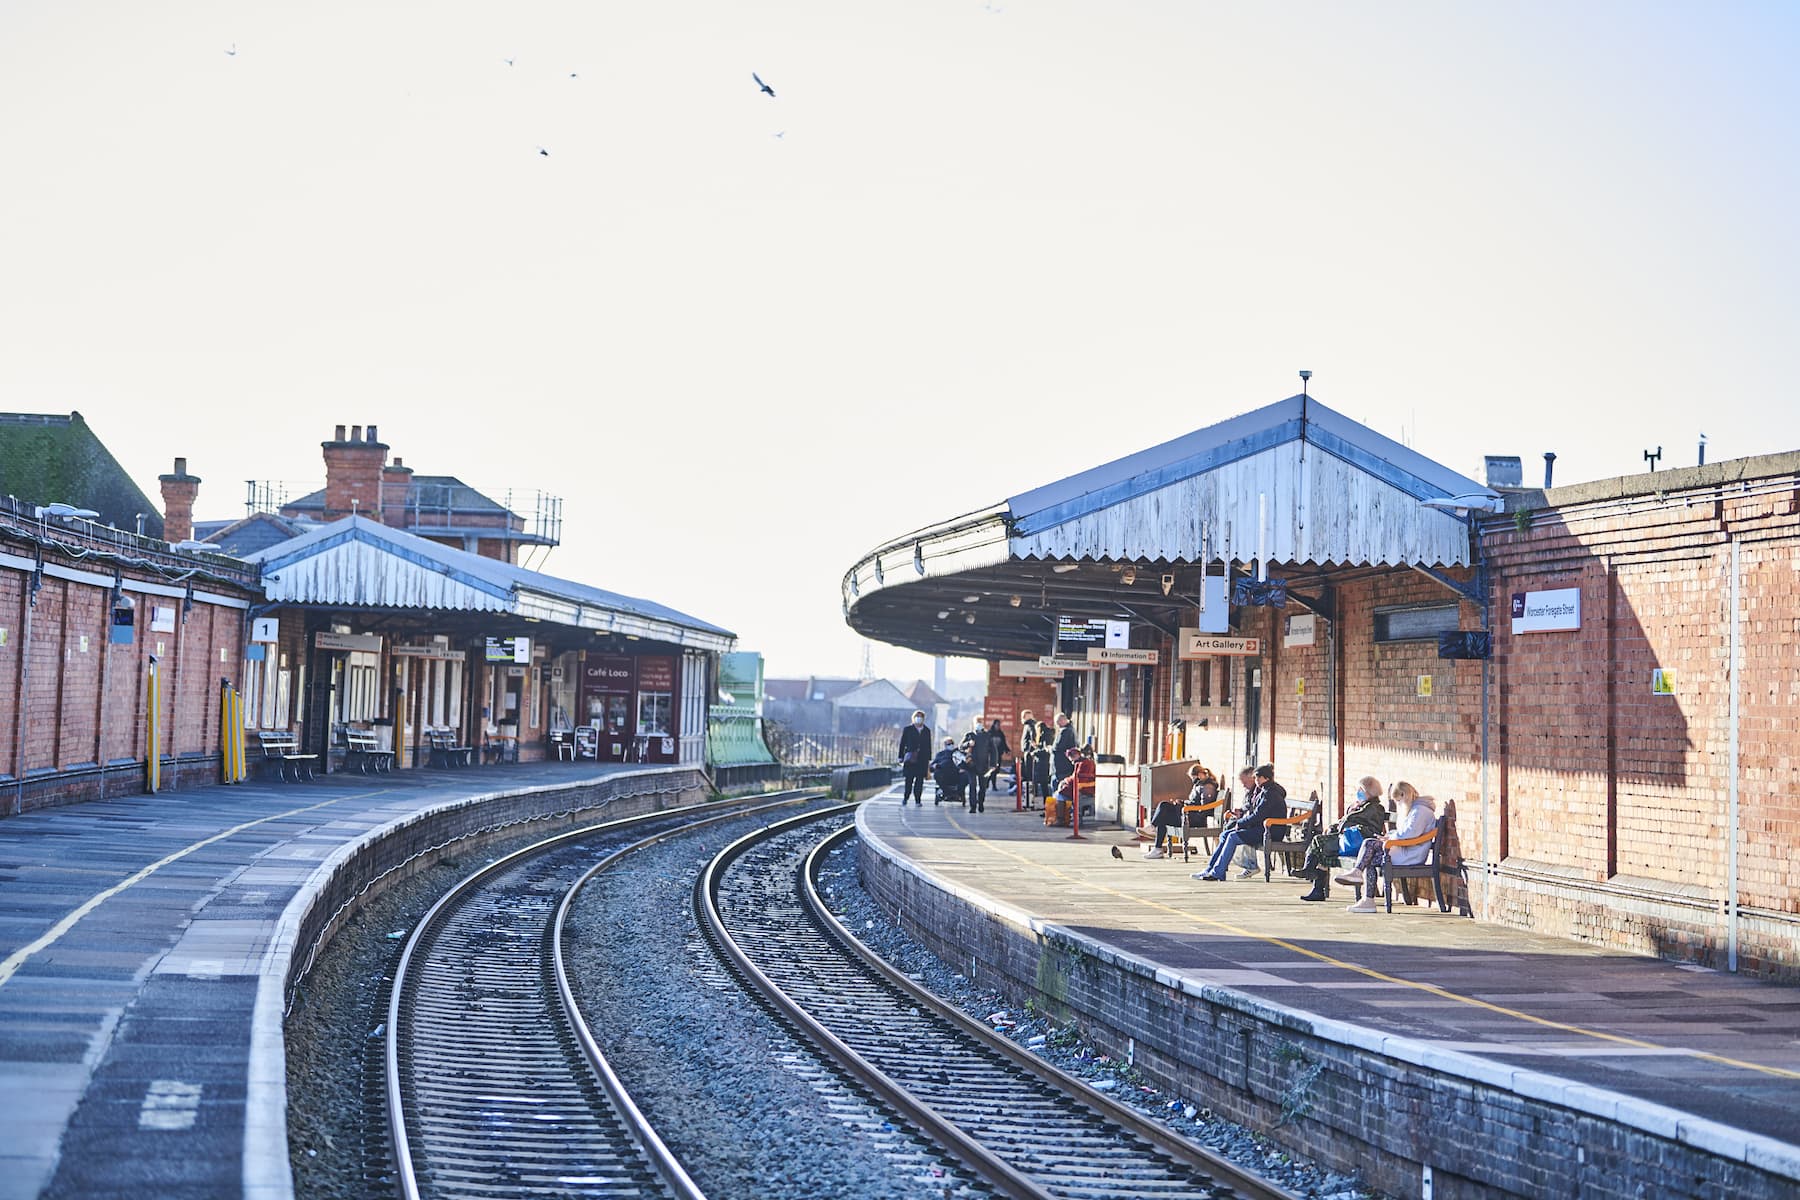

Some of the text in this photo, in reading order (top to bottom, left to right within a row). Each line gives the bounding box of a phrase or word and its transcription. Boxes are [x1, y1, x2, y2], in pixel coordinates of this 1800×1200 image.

[262, 623, 268, 636] 1
[1195, 640, 1244, 650] Art Gallery
[1109, 652, 1147, 660] Information
[1050, 659, 1074, 668] Waiting
[587, 667, 629, 677] Café Loco
